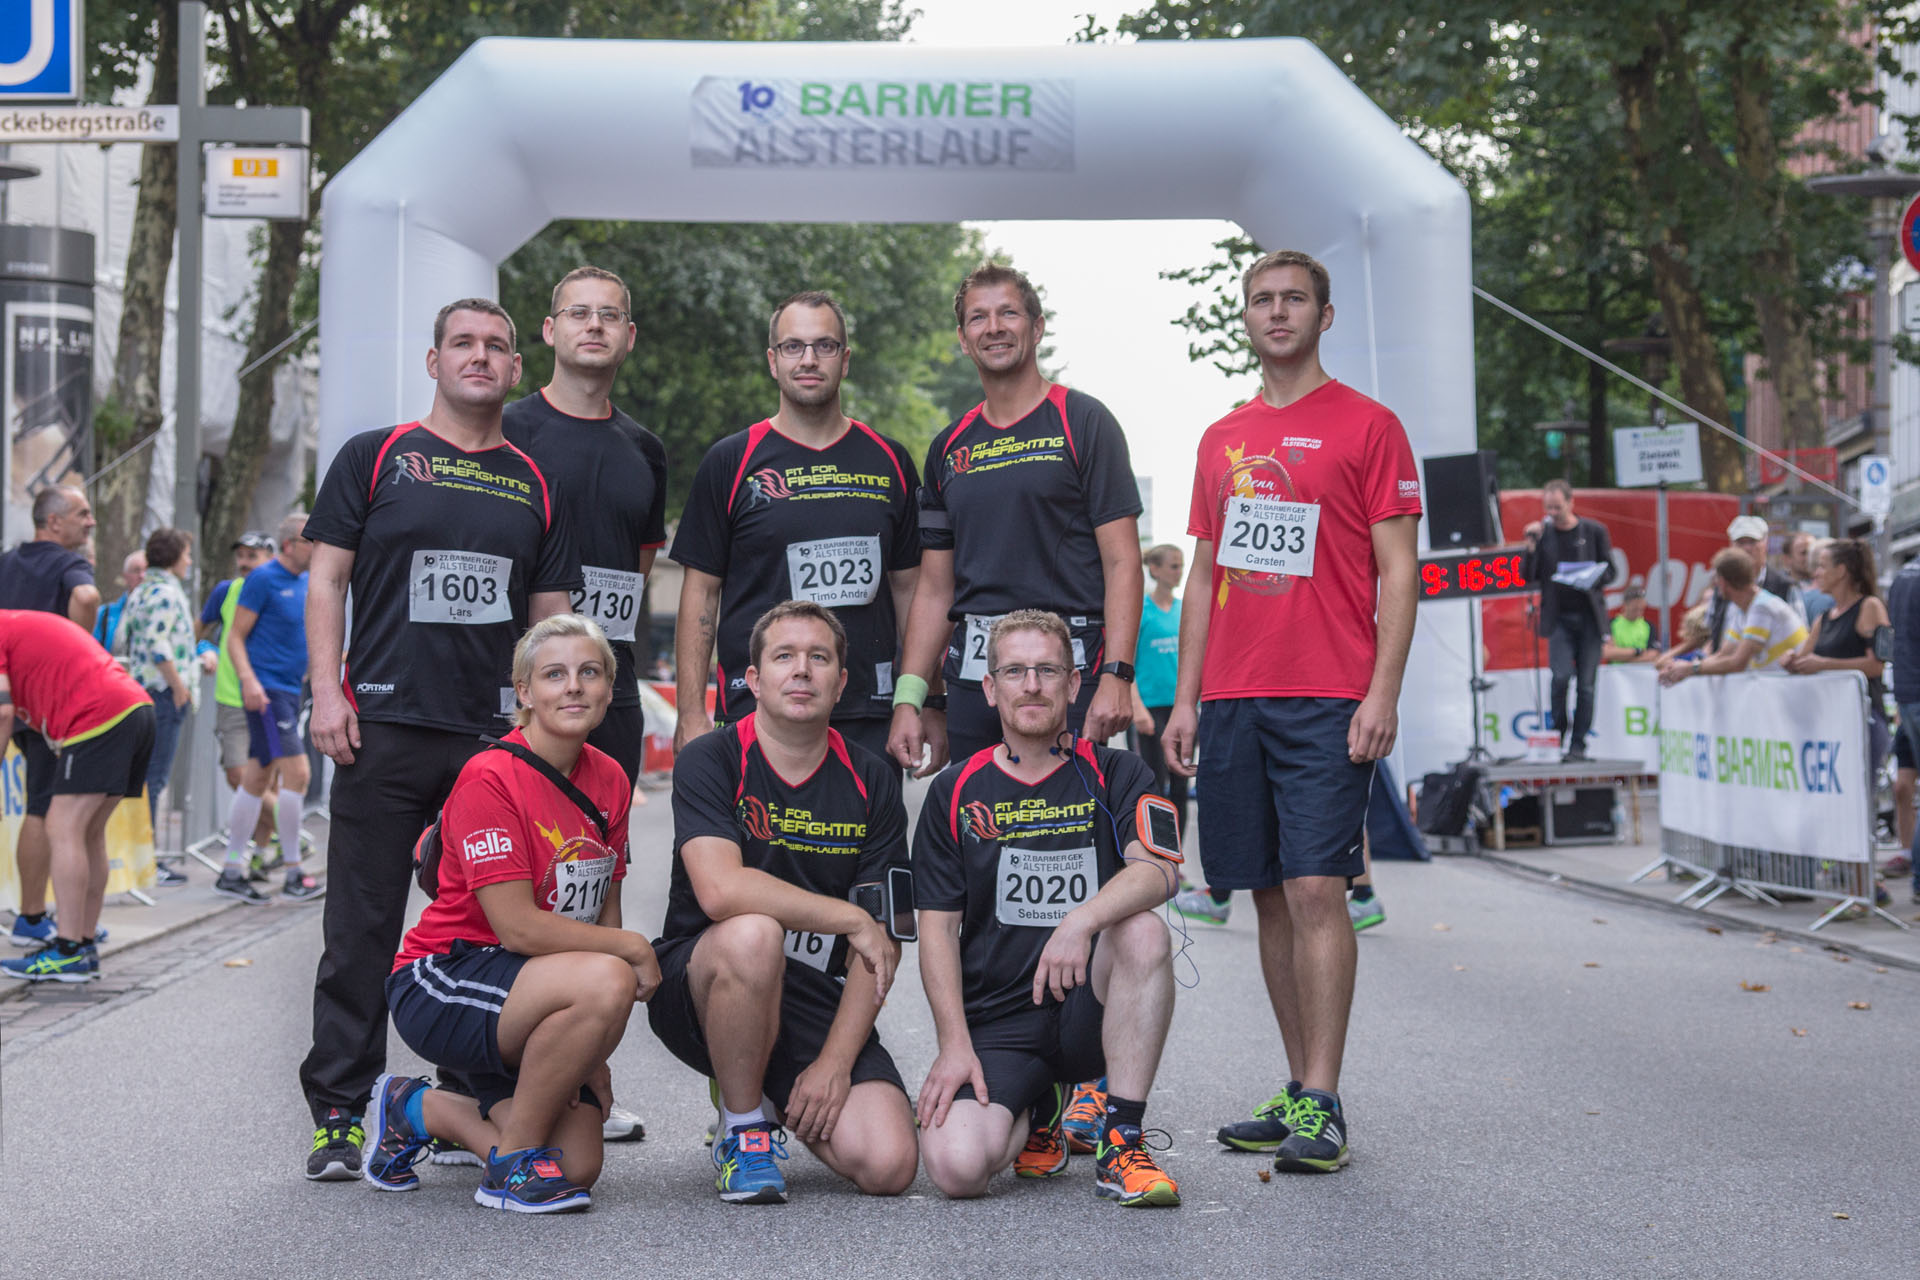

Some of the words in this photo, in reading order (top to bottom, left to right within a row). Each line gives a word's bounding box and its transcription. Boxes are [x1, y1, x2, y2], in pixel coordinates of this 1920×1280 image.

[800, 82, 1032, 117] BARMER
[734, 128, 1032, 166] ALSTERLAUF
[970, 436, 1064, 461] FIREFIGHTING
[972, 441, 989, 452] FIT
[992, 436, 1015, 447] FOR
[432, 456, 450, 465] FIT
[456, 459, 481, 470] FOR
[785, 467, 804, 477] FIT
[811, 464, 838, 474] FOR
[432, 464, 531, 494] FIREFIGHTING
[786, 473, 890, 488] FIREFIGHTING
[1263, 504, 1291, 512] BARMER
[1292, 506, 1307, 514] GEK
[1253, 511, 1306, 523] ALSTERLAUF
[1230, 521, 1305, 554] 2033
[823, 541, 854, 550] BARMER
[449, 555, 481, 564] BARMER
[815, 547, 870, 559] ALSTERLAUF
[1246, 554, 1285, 567] Carsten
[439, 562, 498, 574] ALSTERLAUF
[799, 558, 873, 590] 2023
[597, 572, 624, 581] BARMER
[421, 573, 497, 605] 1603
[588, 579, 636, 592] ALSTERLAUF
[810, 592, 837, 602] Timo
[840, 589, 868, 599] André
[571, 588, 634, 621] 2130
[449, 606, 473, 618] Lars
[1717, 735, 1799, 792] BARMER
[1801, 740, 1843, 795] GEK
[994, 802, 1013, 813] FIT
[1019, 799, 1047, 809] FOR
[785, 807, 812, 821] FOR
[463, 831, 513, 861] hella
[577, 863, 613, 878] ALSTERLAUF
[1023, 861, 1084, 872] ALSTERLAUF
[560, 875, 610, 912] 2110
[1005, 873, 1087, 904] 2020
[1018, 908, 1068, 919] Sebastia
